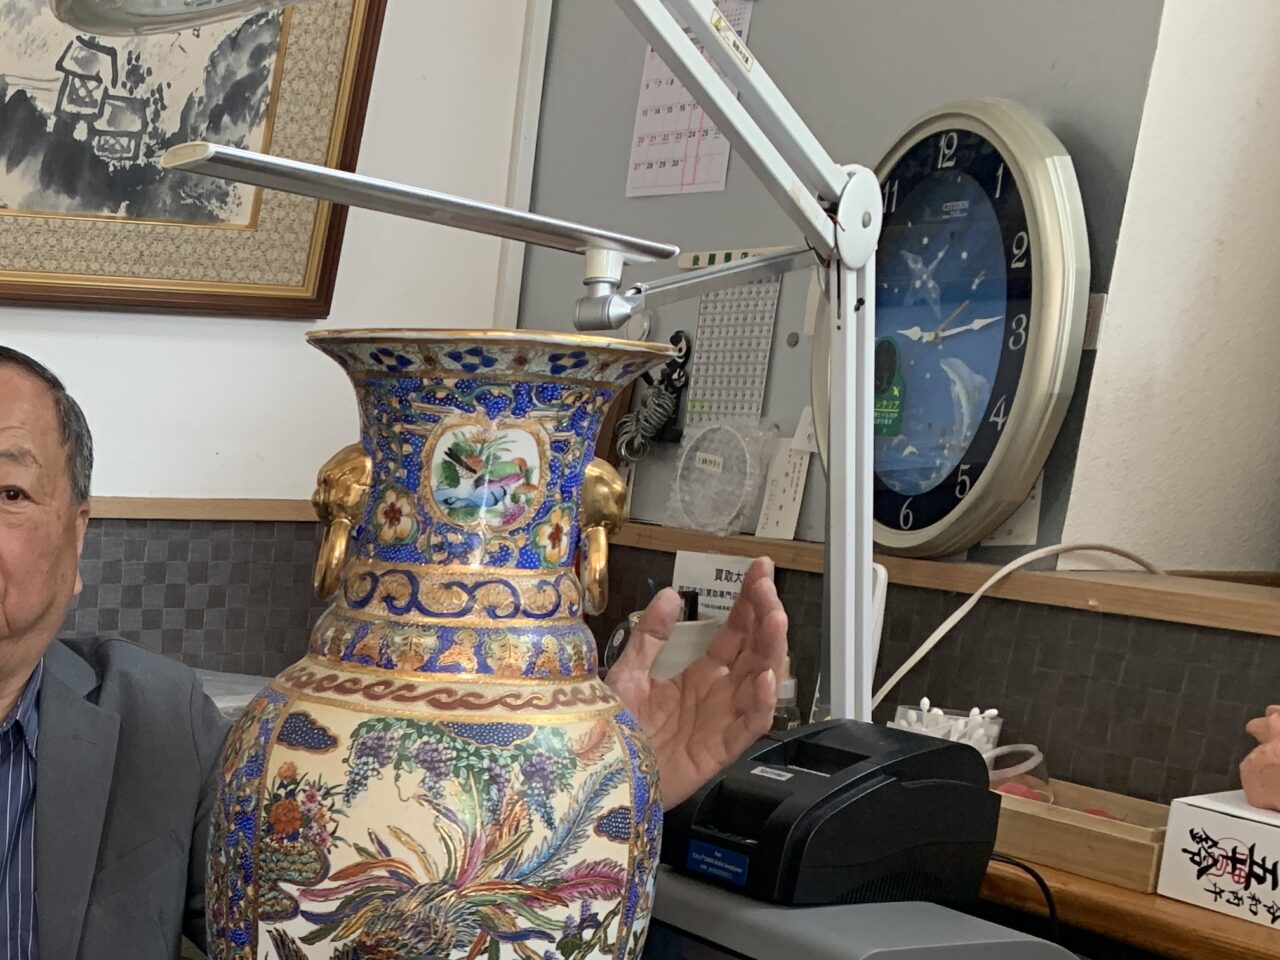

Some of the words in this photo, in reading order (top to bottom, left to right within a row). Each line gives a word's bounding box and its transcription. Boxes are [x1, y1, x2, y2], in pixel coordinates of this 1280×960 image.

[937, 131, 959, 168] 12
[883, 178, 899, 214] 11
[995, 163, 1004, 199] 1
[1011, 232, 1028, 269] 2
[1008, 314, 1027, 350] 3
[989, 395, 1007, 431] 4
[955, 464, 971, 499] 5
[899, 497, 914, 531] 6
[714, 568, 746, 584] 買取大
